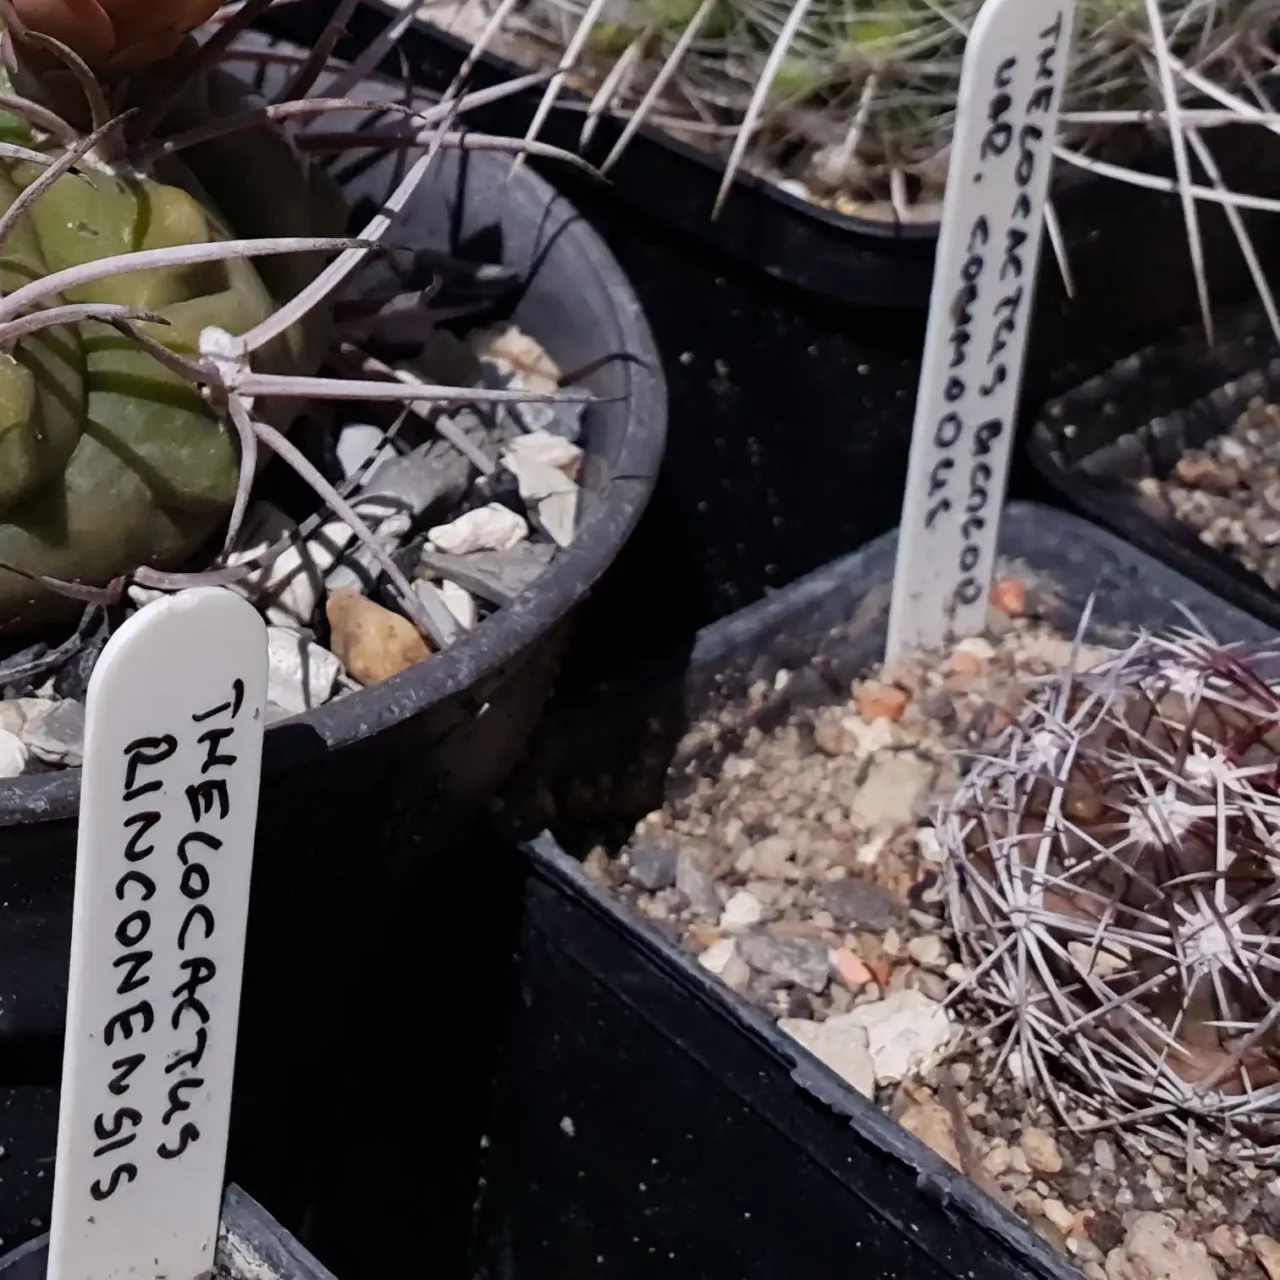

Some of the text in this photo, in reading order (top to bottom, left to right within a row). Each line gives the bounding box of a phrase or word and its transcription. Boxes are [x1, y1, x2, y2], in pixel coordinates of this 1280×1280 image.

[979, 10, 1064, 398] THELOCACTUS
[90, 733, 178, 1202] RINCONENSIS
[157, 677, 246, 1161] THELOCACTUS
